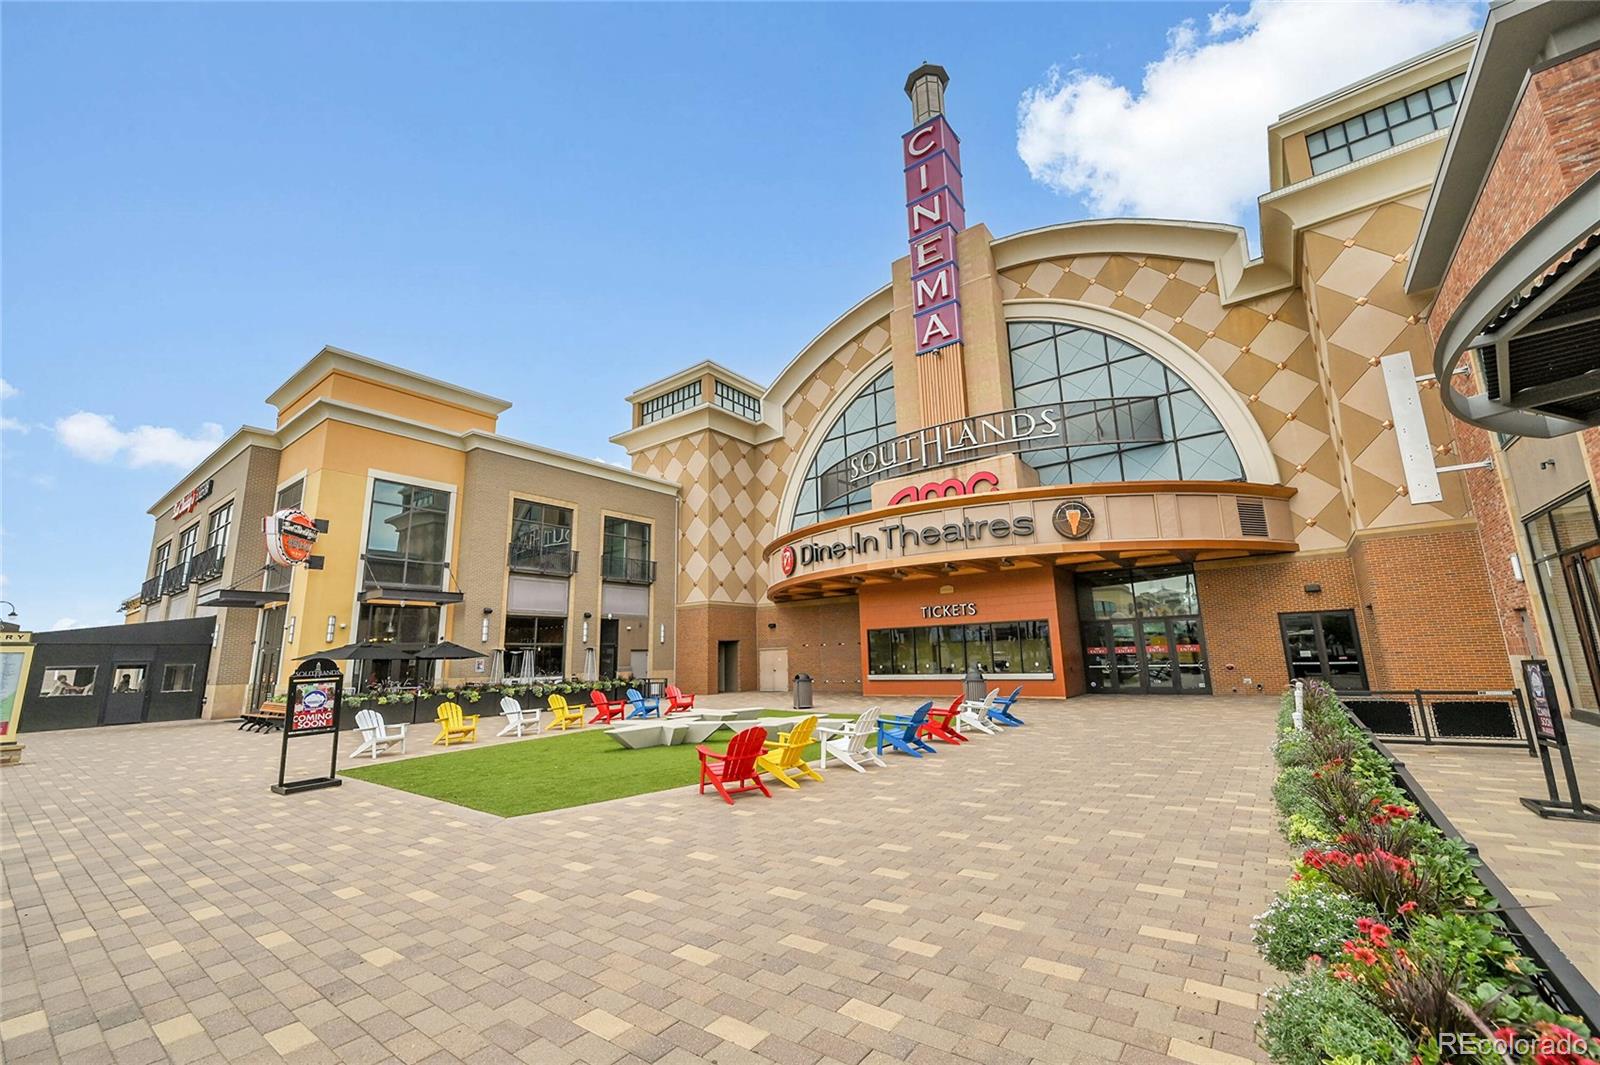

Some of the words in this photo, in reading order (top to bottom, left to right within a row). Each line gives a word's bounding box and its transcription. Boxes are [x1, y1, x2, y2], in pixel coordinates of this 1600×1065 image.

[907, 124, 952, 347] CINEMA
[850, 408, 1059, 478] SOUTHLANDS
[800, 532, 879, 567] Dine-In
[879, 515, 1035, 549] Theatres
[920, 602, 977, 619] TICKETS
[293, 712, 333, 723] COMING
[298, 719, 327, 729] SOON
